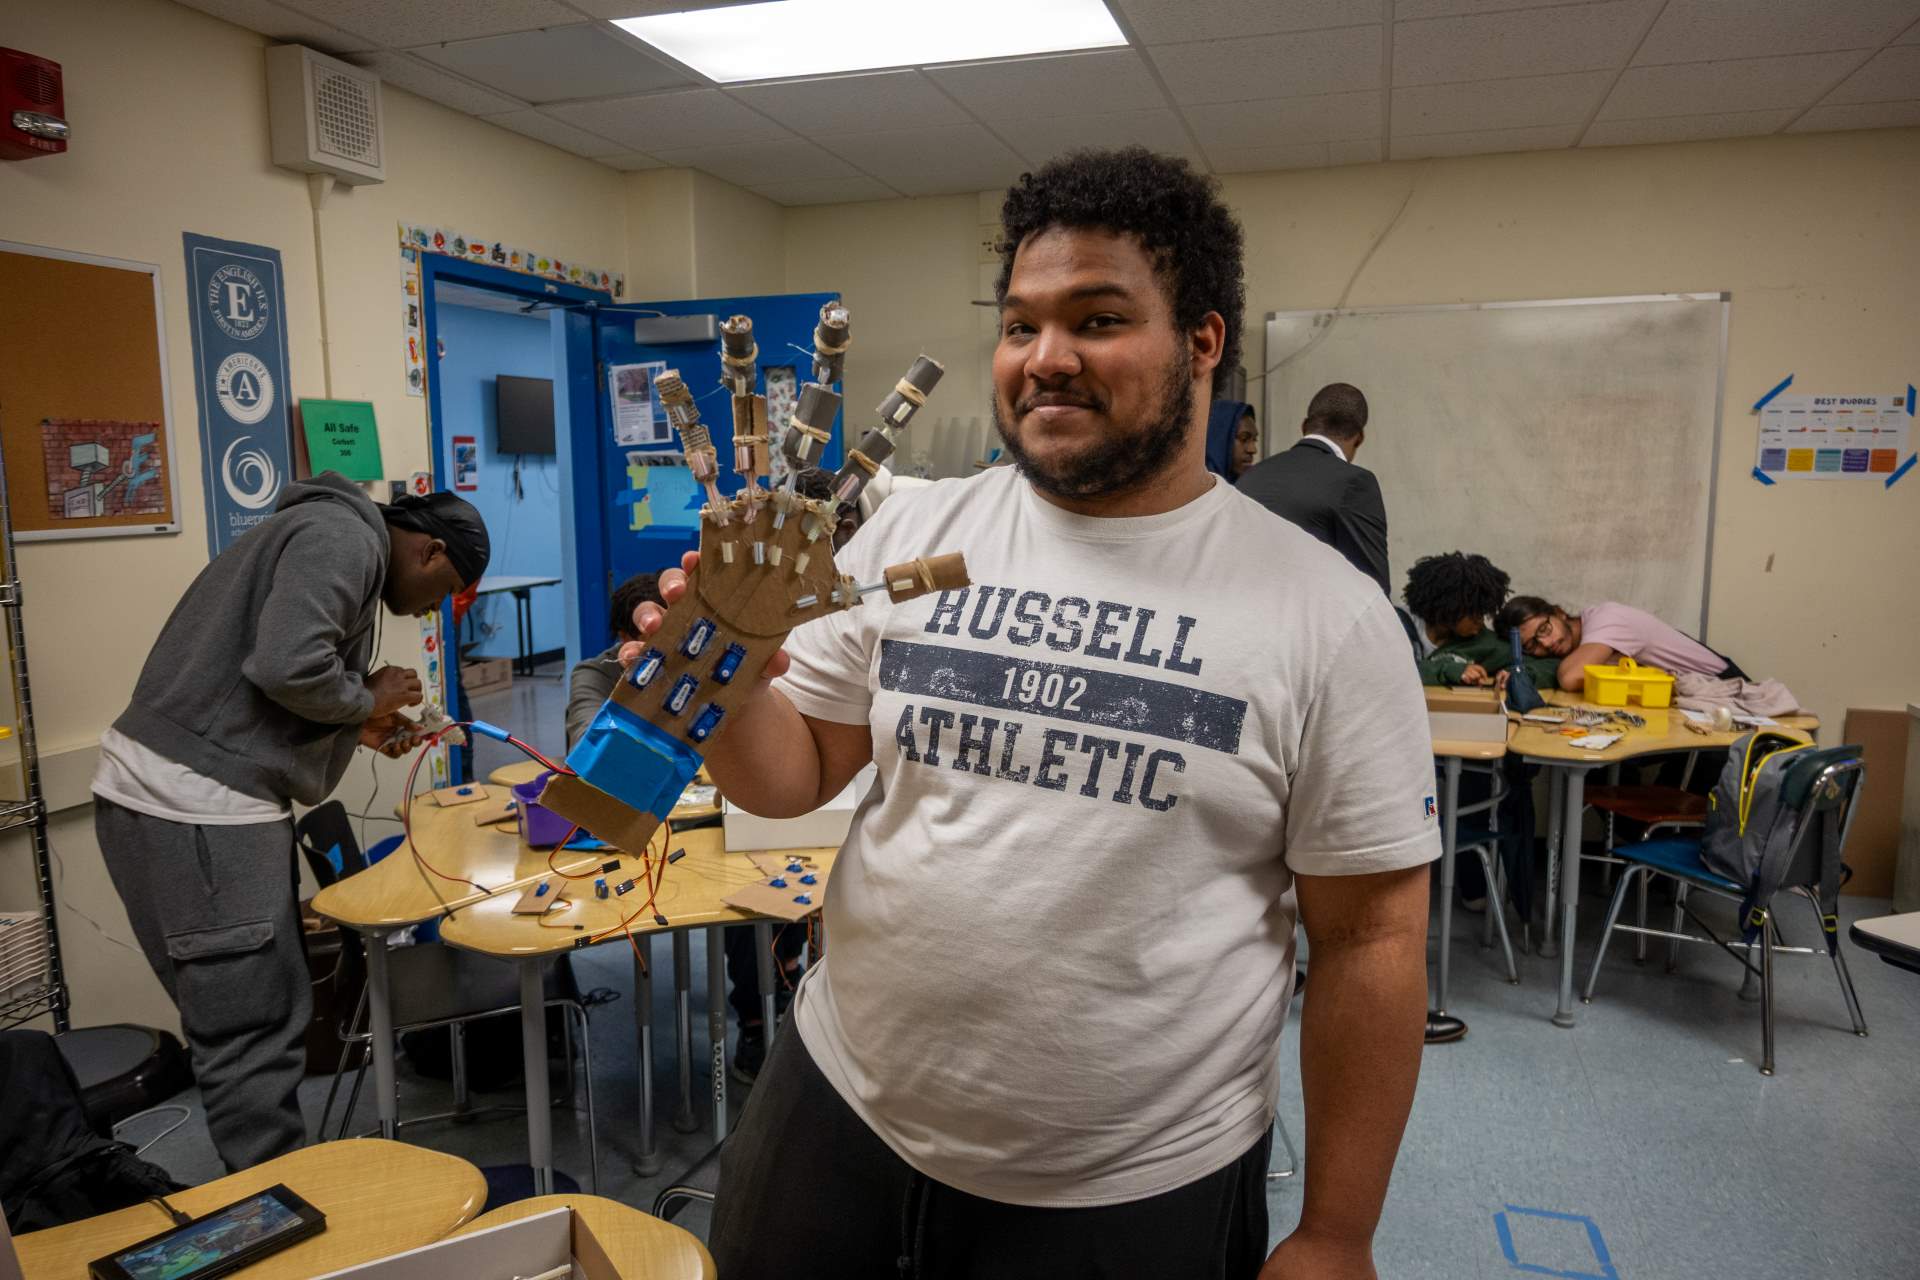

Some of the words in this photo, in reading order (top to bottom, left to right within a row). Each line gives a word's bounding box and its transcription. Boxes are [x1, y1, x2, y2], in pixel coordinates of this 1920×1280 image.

[29, 137, 59, 152] FIRE
[208, 279, 221, 304] THE
[216, 267, 259, 289] ENGLISH
[224, 281, 254, 322] E
[236, 372, 257, 400] A
[1814, 397, 1837, 406] BEST
[1839, 397, 1877, 406] BUDDIES
[324, 422, 336, 433] All
[338, 423, 360, 434] Safe
[228, 511, 273, 526] bluepr
[924, 585, 1202, 676] RUSSELL
[1001, 666, 1088, 712] 1902
[895, 704, 1187, 812] ATHLETIC
